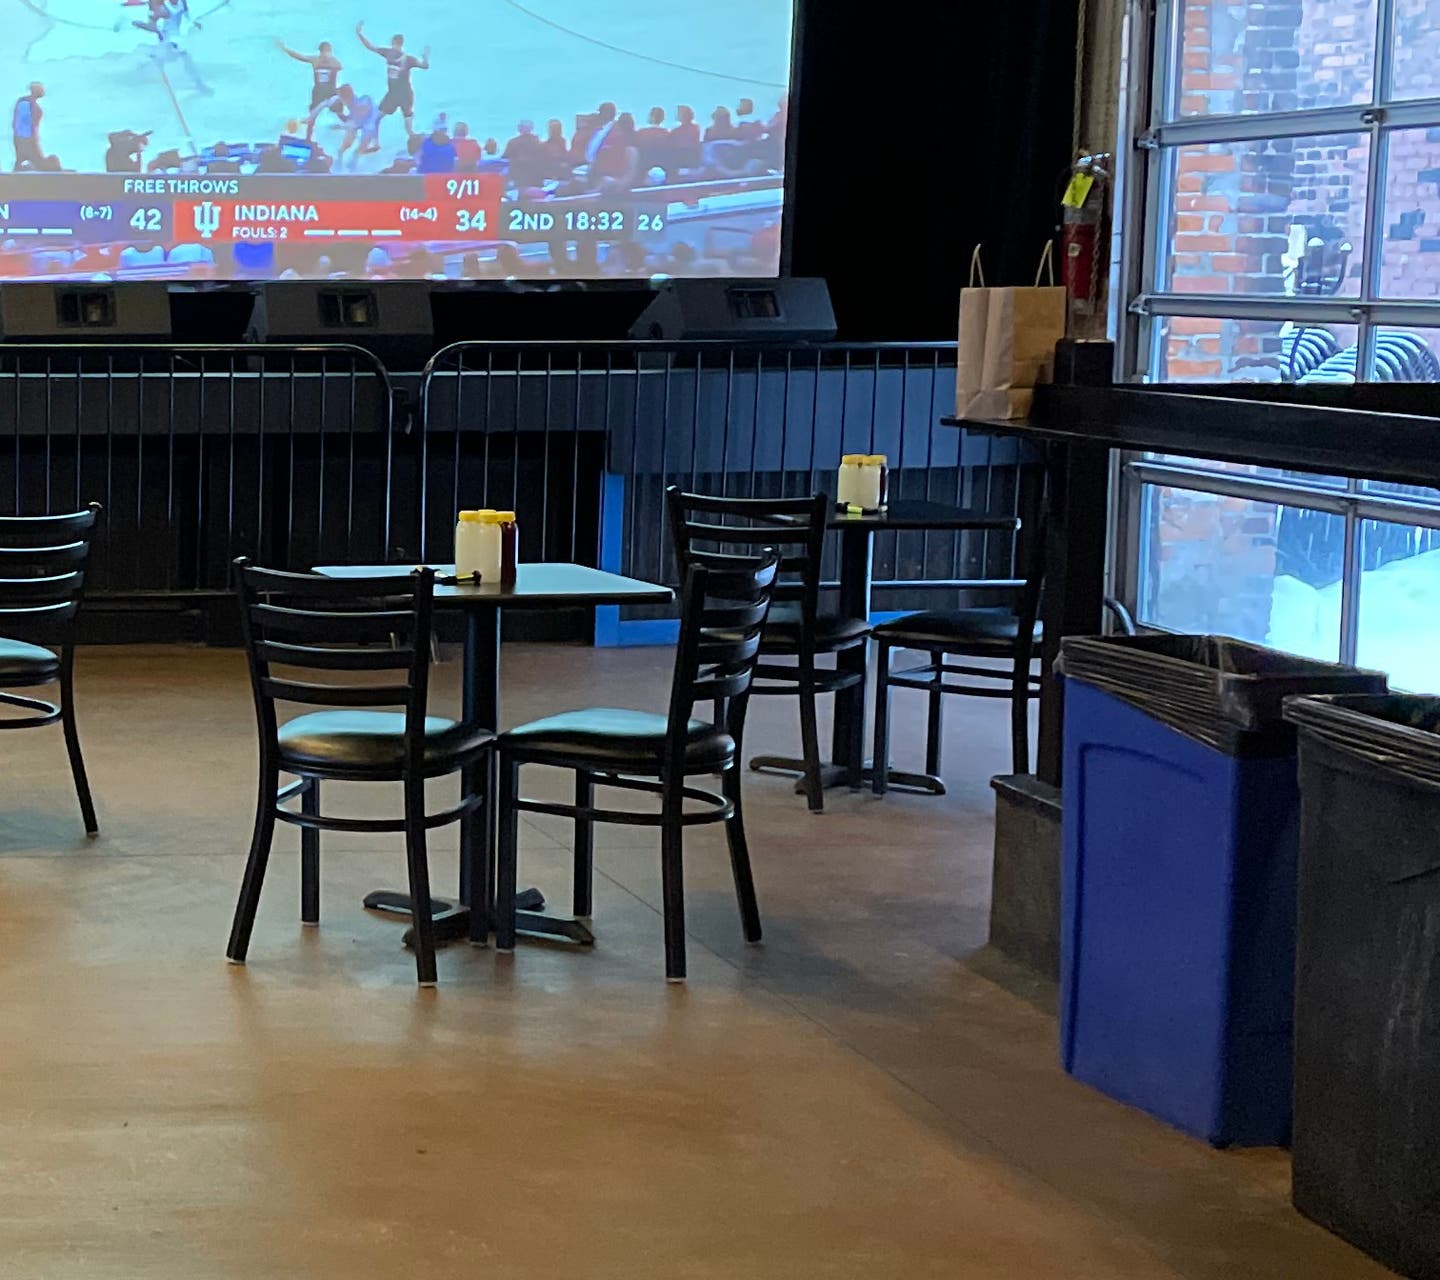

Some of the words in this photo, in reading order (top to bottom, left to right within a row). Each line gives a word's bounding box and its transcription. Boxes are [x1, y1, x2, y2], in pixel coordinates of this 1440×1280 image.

[124, 179, 165, 194] FREE
[168, 180, 239, 194] THROWS
[446, 180, 480, 199] 9/11
[130, 208, 162, 230] 42
[234, 205, 319, 221] INDIANA
[399, 207, 438, 222] (14-4)
[456, 210, 487, 231] 34
[509, 210, 554, 230] 2ND
[565, 210, 624, 230] 18:32
[637, 214, 664, 231] 26
[279, 226, 288, 239] 2
